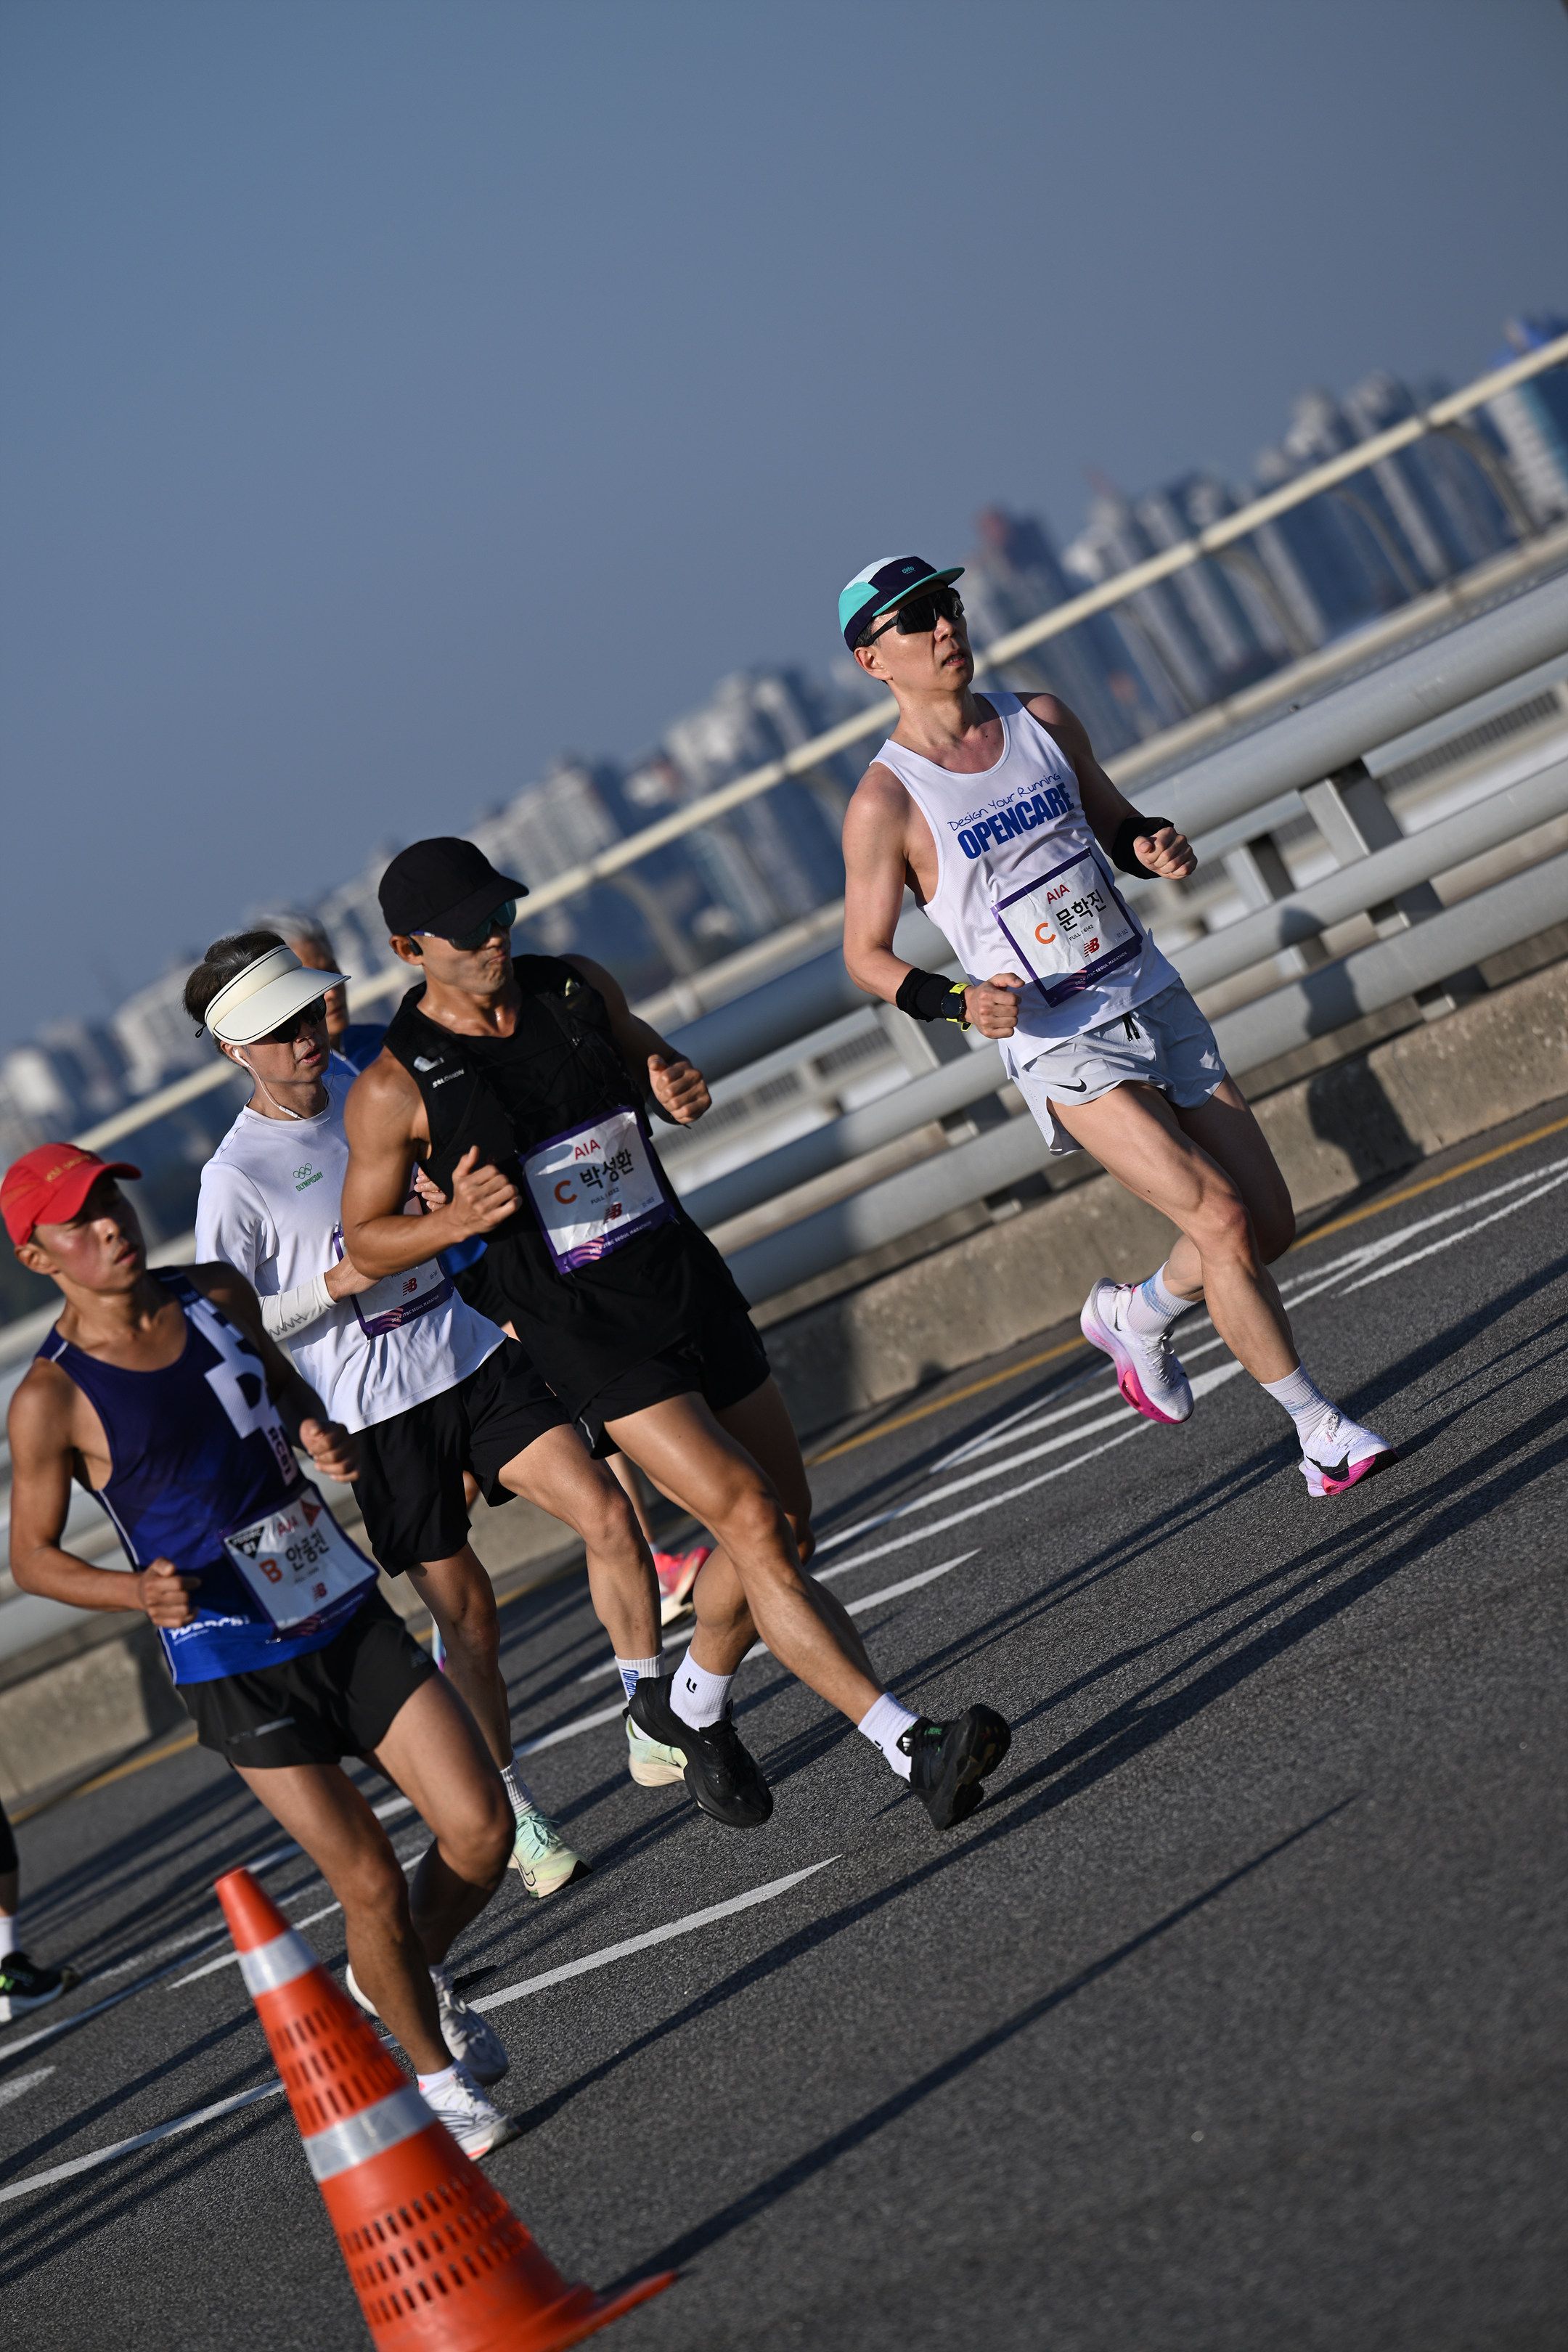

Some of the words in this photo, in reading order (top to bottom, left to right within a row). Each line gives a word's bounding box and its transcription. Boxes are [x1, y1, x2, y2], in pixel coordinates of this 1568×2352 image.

[947, 808, 988, 831] Design
[988, 793, 1015, 809] Your
[1017, 773, 1061, 798] Running
[957, 782, 1075, 859] OPENCARE
[1046, 883, 1071, 905] AIA
[1034, 922, 1056, 944] C
[1055, 889, 1107, 932] 문학진
[1069, 932, 1082, 942] FULL
[1095, 963, 1108, 973] SEOUL
[1108, 951, 1127, 965] MARATHON
[574, 1139, 601, 1160] AIA
[554, 1180, 578, 1205] C
[579, 1148, 634, 1189] 박성환
[259, 1557, 283, 1585] B
